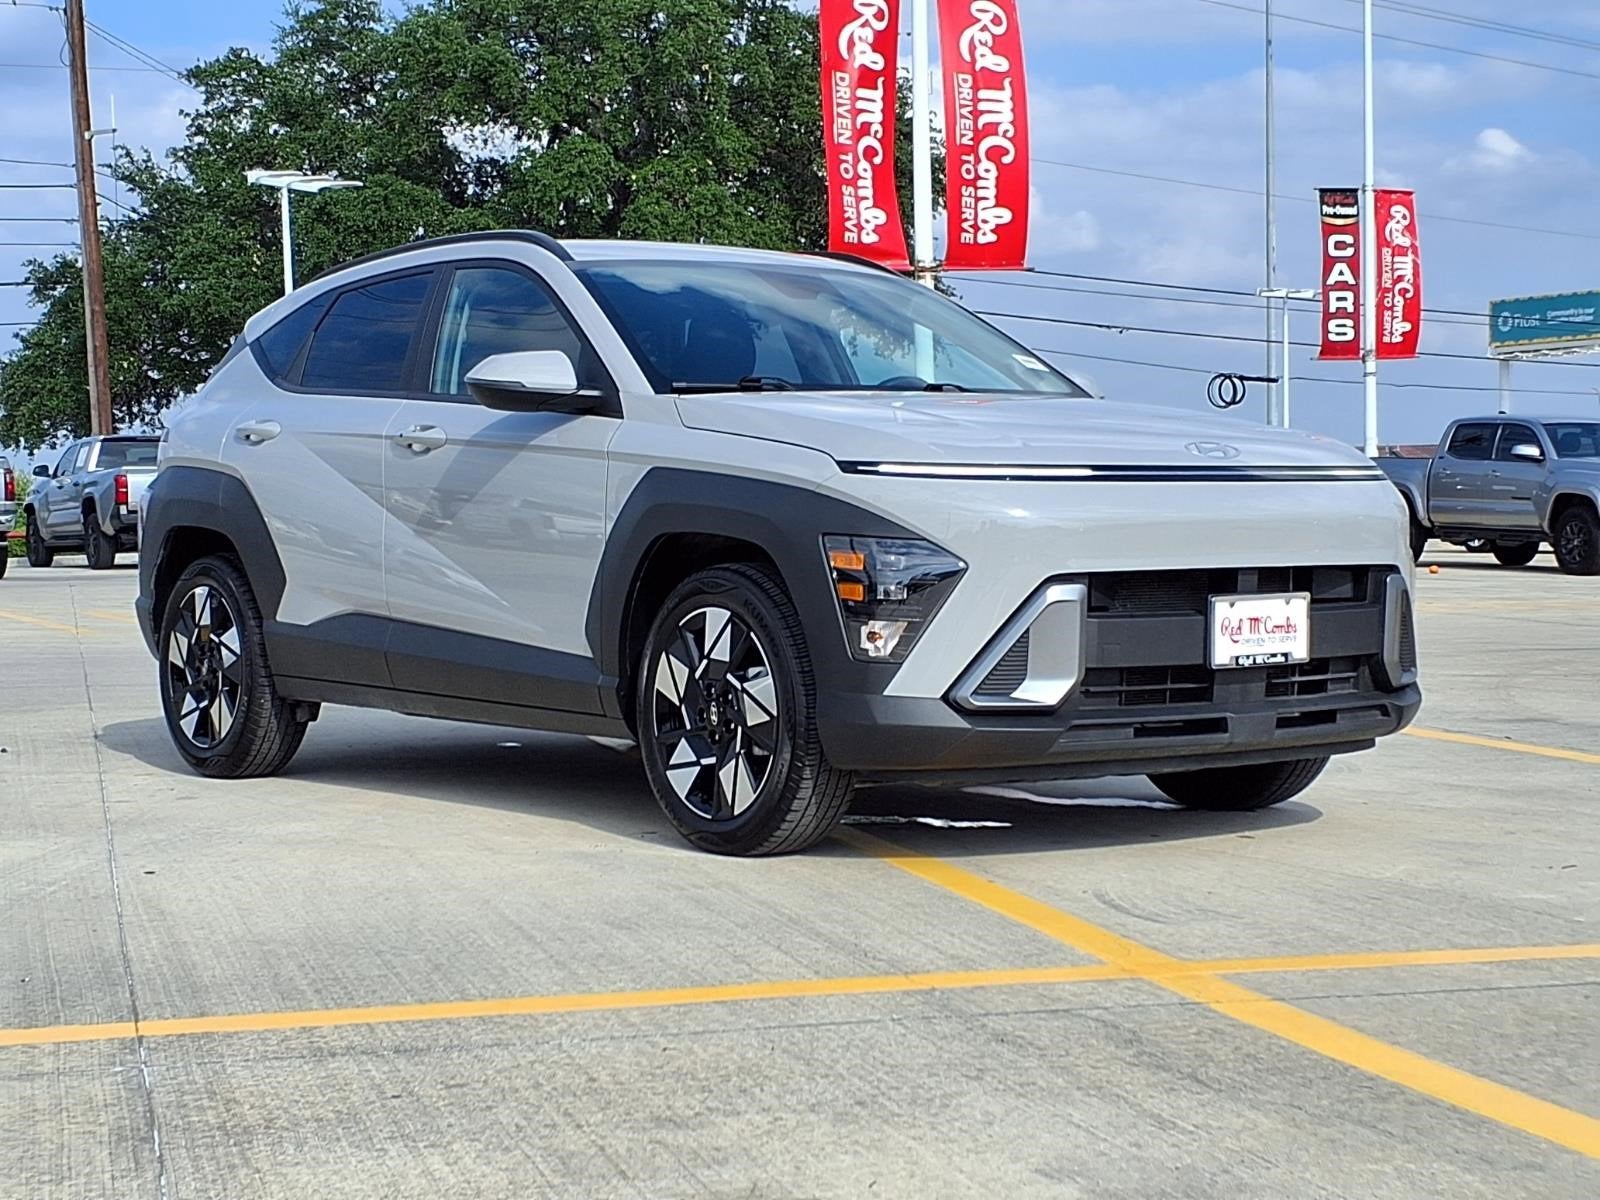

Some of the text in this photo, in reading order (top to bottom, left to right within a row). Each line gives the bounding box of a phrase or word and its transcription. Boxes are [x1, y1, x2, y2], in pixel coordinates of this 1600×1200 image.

[834, 71, 858, 244] DRIVEN TO SERVE
[838, 0, 889, 245] Red McCombs
[956, 72, 975, 245] DRIVEN TO SERVE
[959, 0, 1015, 245] Red McCombs
[1326, 234, 1357, 342] CARS
[1382, 248, 1392, 343] DRIVEN TO SERVE
[1384, 204, 1411, 247] Red
[1221, 616, 1297, 643] Red McCombs
